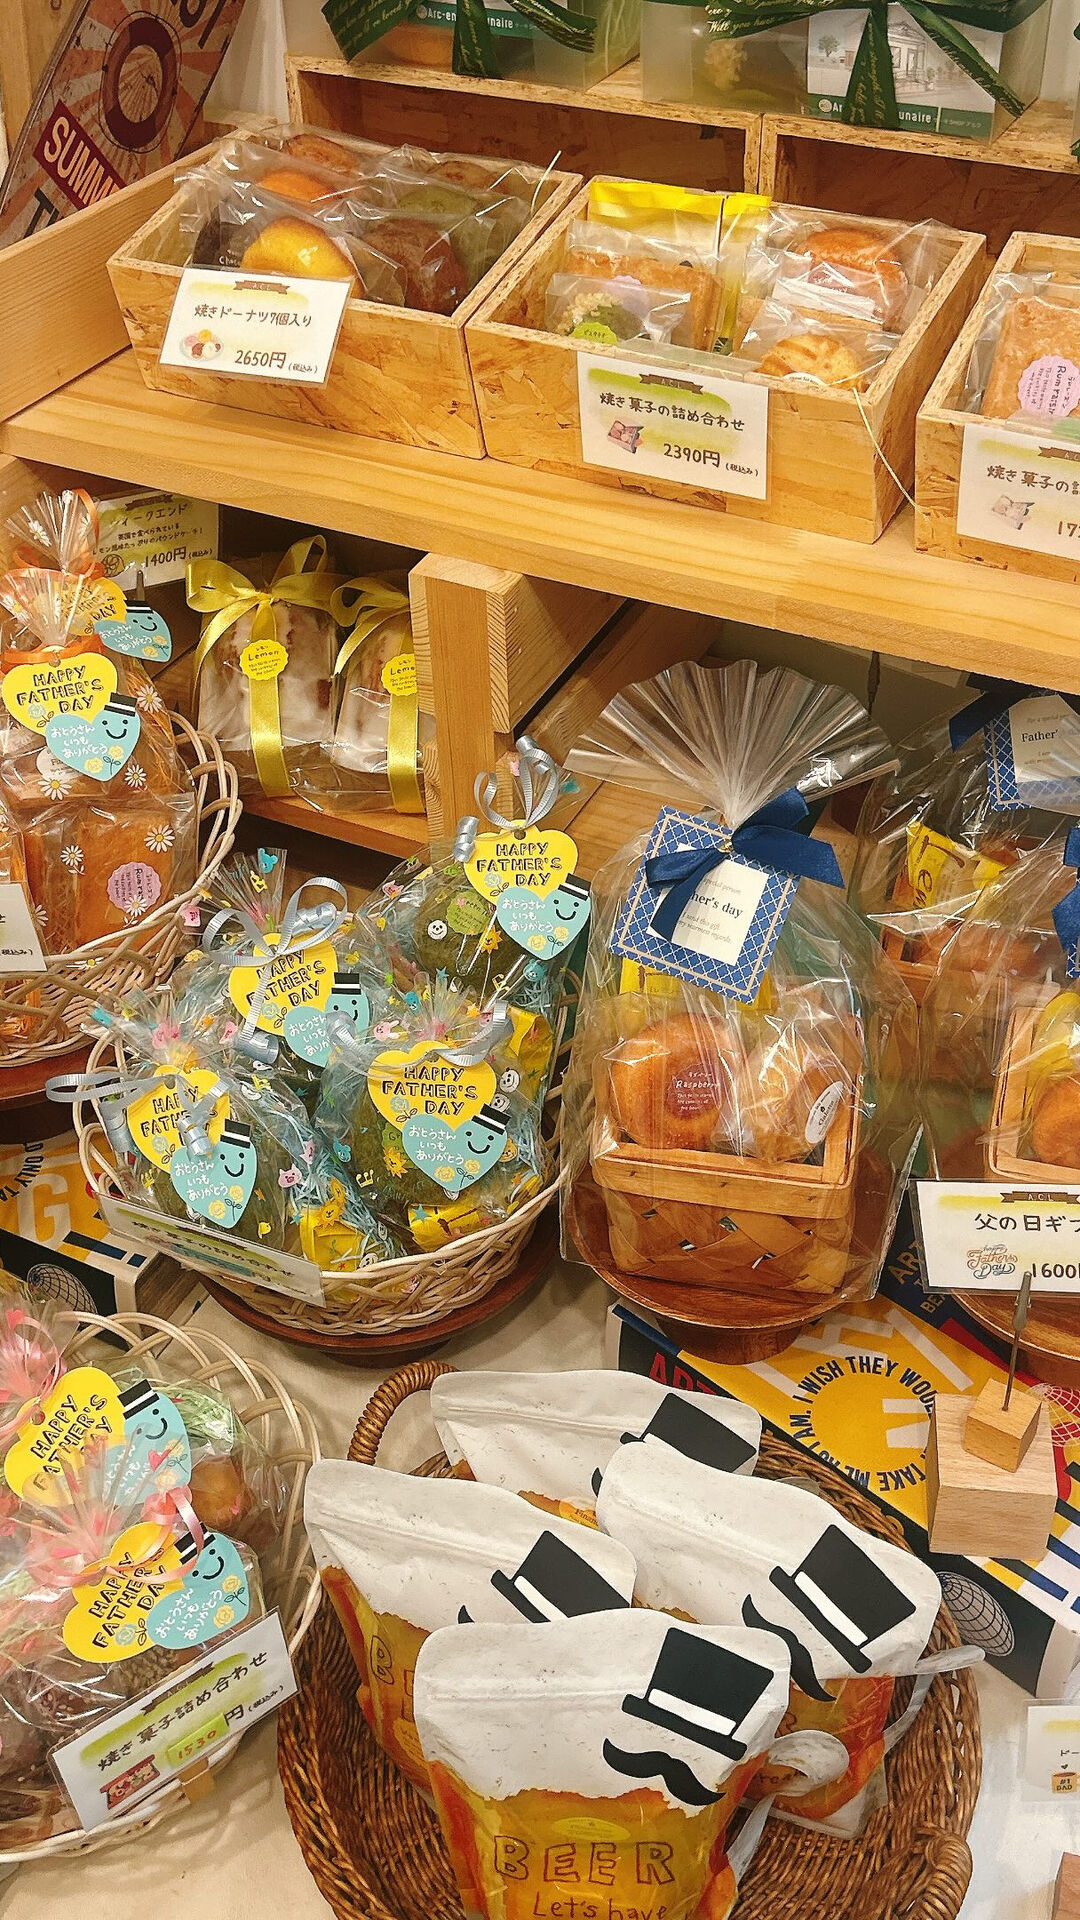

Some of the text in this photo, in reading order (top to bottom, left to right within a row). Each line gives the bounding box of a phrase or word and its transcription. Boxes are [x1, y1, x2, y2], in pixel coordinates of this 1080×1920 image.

[43, 116, 119, 206] SUMM
[194, 303, 312, 328] 焼きドーナツ7個入り
[234, 350, 287, 370] 2650円
[600, 392, 745, 432] 焼き菓子の詰め合わせ
[663, 443, 721, 468] 2390円
[1058, 520, 1080, 538] 17
[145, 546, 187, 568] 1400円
[248, 650, 280, 662] Lemon
[33, 665, 87, 687] HAPPY
[390, 666, 415, 676] Lemo
[16, 678, 104, 707] FATHER'S
[59, 694, 94, 714] DAY
[50, 724, 95, 739] おとうさん
[64, 736, 89, 745] いつも
[61, 744, 109, 759] ありがとう
[495, 841, 549, 857] HAPPY
[476, 857, 562, 873] FATHER'S
[515, 872, 551, 887] DAY
[501, 899, 546, 911] おとうさん
[721, 902, 743, 919] day
[512, 912, 537, 921] いつも
[509, 920, 554, 932] ありがとう
[288, 980, 320, 1006] DAY
[404, 1065, 464, 1082] HAPPY
[382, 1080, 478, 1099] FATHER'S
[424, 1100, 464, 1115] DAY
[409, 1125, 456, 1140] おとうさん
[420, 1141, 446, 1151] いつも
[416, 1149, 464, 1165] ありがとう
[174, 1161, 215, 1177] おとうさん
[187, 1175, 210, 1186] いつも
[186, 1183, 229, 1200] ありがとう
[973, 1261, 1015, 1280] Day
[1031, 1263, 1080, 1279] 1600
[797, 1359, 845, 1395] WISH
[845, 1355, 899, 1377] THEY
[30, 1394, 77, 1459] HAPPY
[155, 1588, 194, 1639] おとうさん
[176, 1602, 200, 1632] いつも
[184, 1589, 223, 1640] ありがとう
[98, 1651, 268, 1772] 焼き菓子詰め合わせ
[494, 1835, 675, 1886] BEER
[533, 1891, 667, 1920] Let's have
